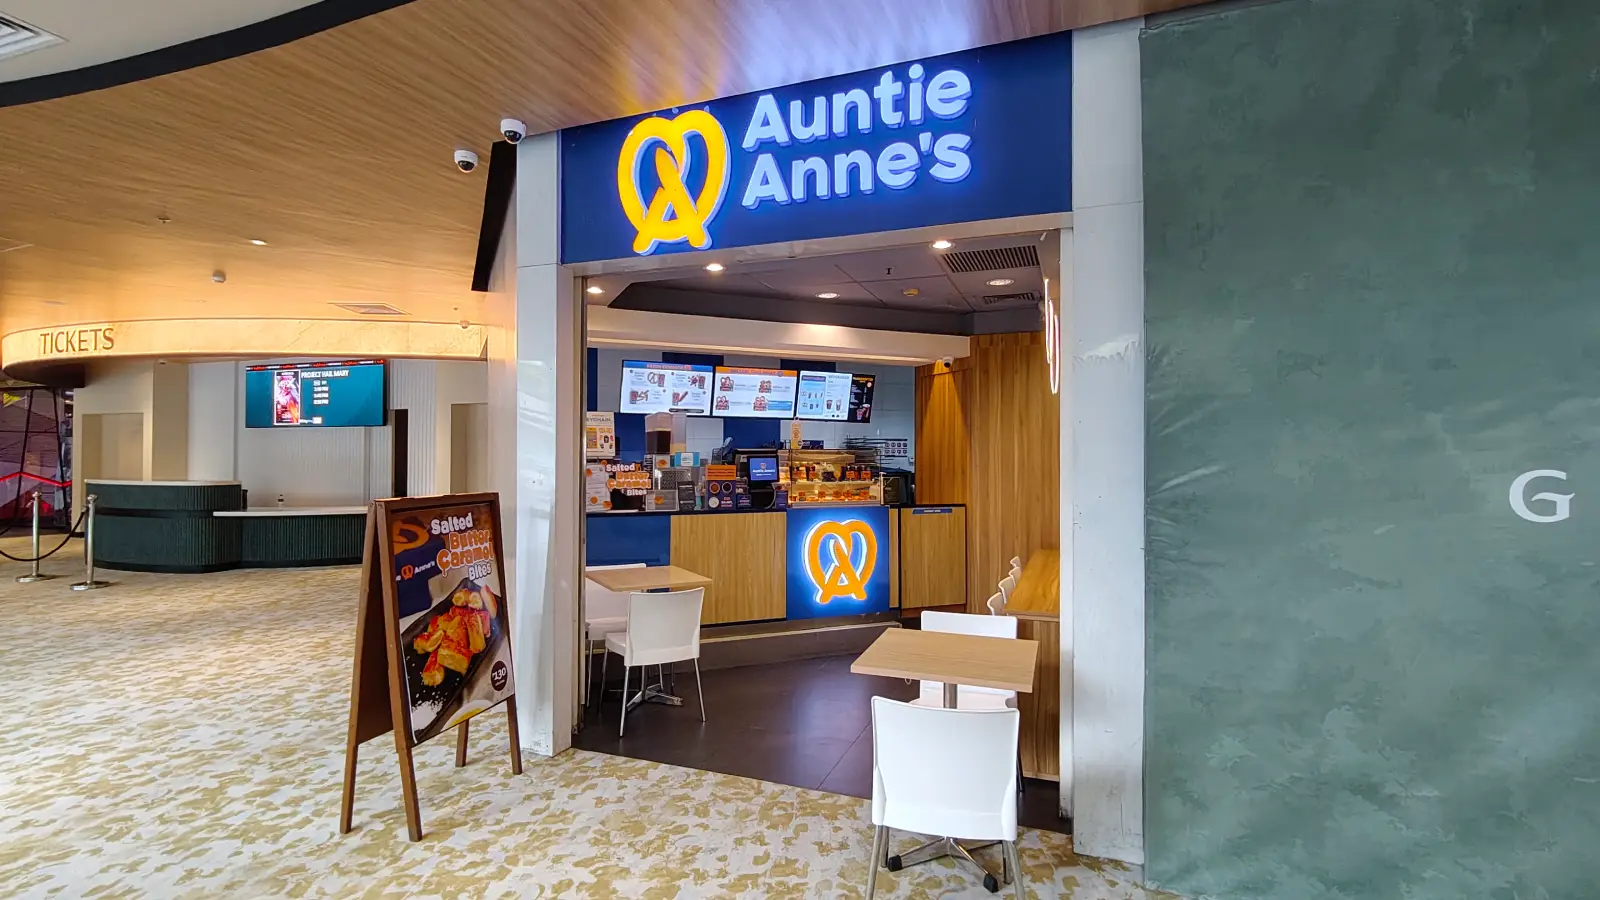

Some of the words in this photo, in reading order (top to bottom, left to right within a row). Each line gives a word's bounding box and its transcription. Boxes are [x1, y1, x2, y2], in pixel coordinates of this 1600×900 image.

[742, 64, 972, 152] Auntie
[741, 131, 972, 209] Anne's
[40, 328, 114, 354] TICKETS
[301, 371, 321, 379] PROJECT
[322, 370, 334, 378] HAIL
[605, 463, 636, 472] Salted
[616, 471, 650, 480] Butter
[607, 478, 652, 491] Caramel
[1509, 469, 1575, 522] G
[430, 512, 473, 536] Salted
[449, 528, 491, 551] Butter
[414, 561, 436, 575] Anne's
[436, 541, 494, 577] Caramel
[467, 562, 492, 581] Bites
